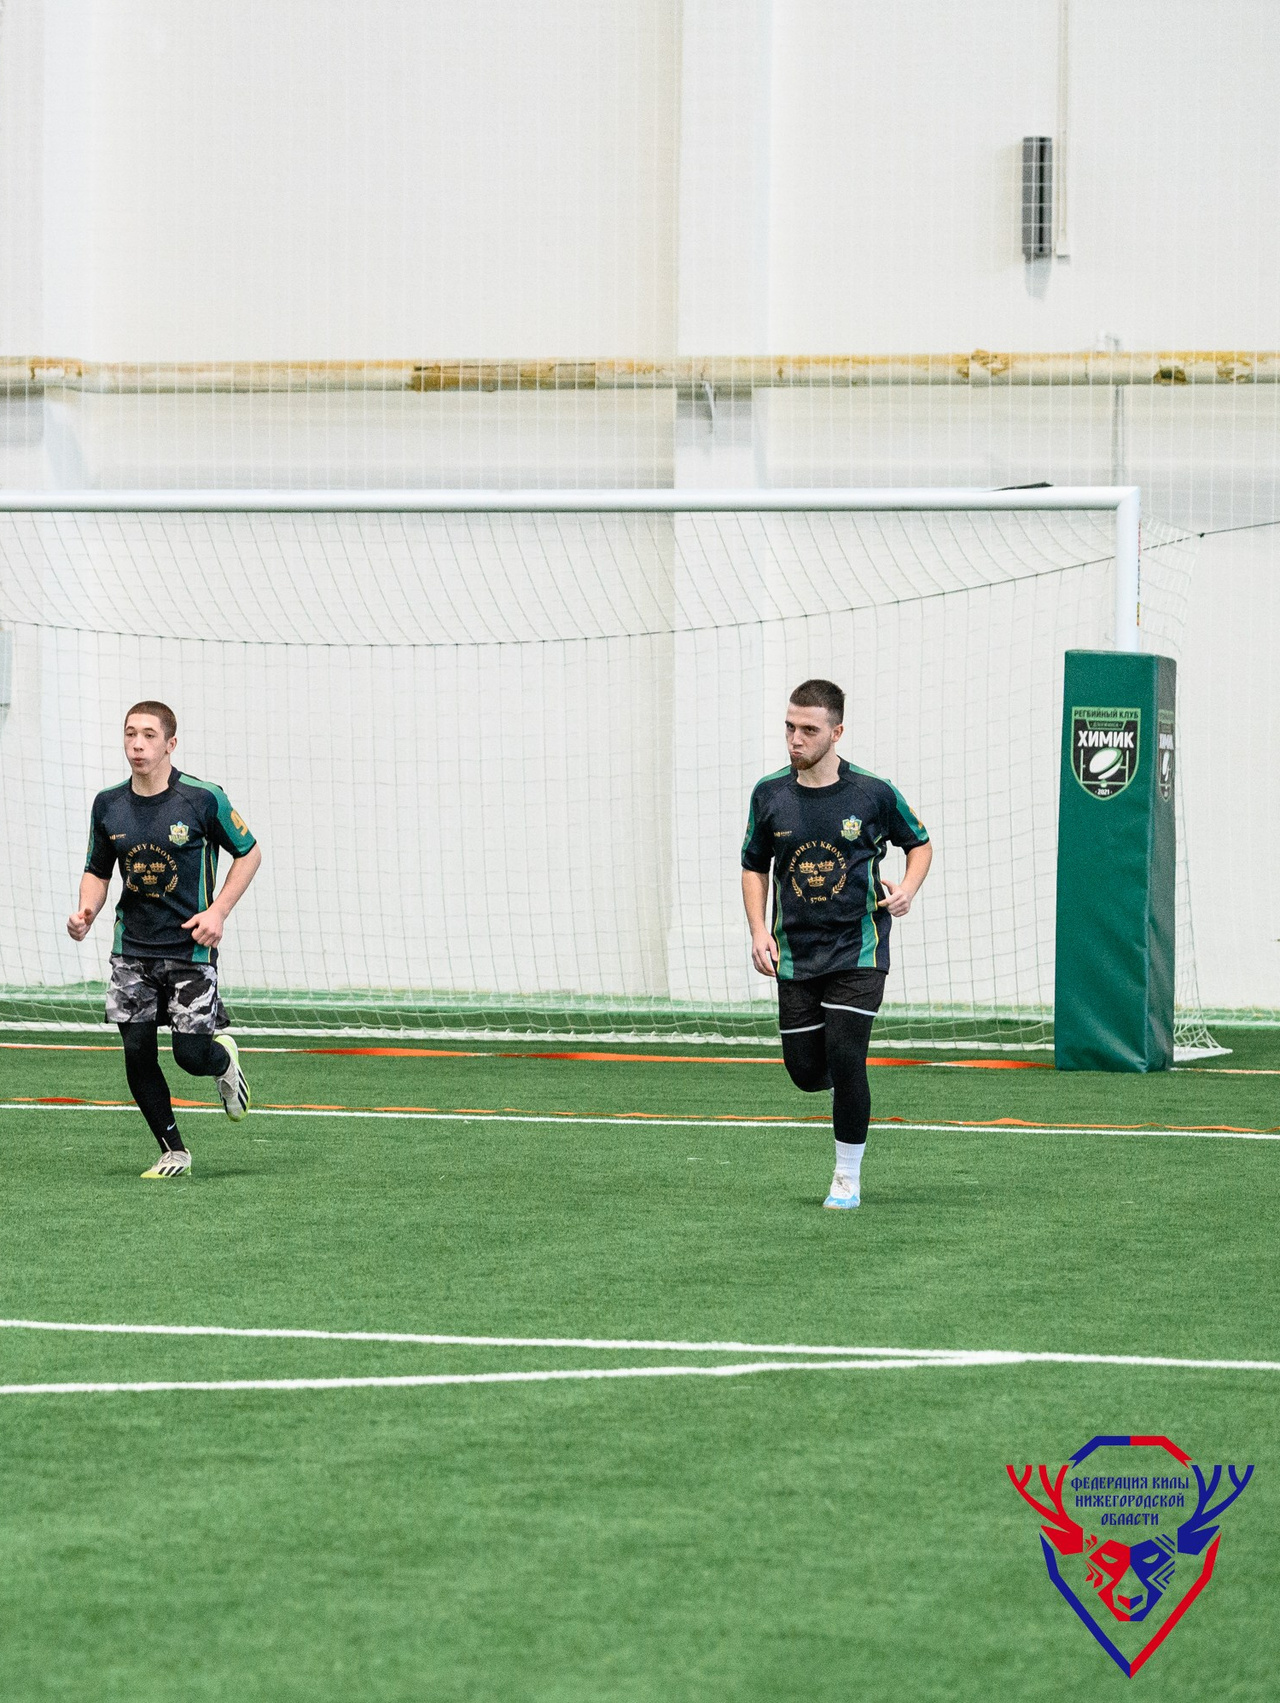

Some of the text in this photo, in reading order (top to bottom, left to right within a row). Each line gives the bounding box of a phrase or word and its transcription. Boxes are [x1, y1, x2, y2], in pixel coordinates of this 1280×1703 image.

[1074, 709, 1139, 719] РЕГБИЙНЫЙ КЛУБ
[1077, 730, 1135, 748] ХИМИК
[230, 809, 248, 837] 9
[128, 843, 148, 858] DREY
[149, 843, 178, 871] KRONEN
[794, 840, 818, 857] DREY
[820, 840, 847, 870] KRONEN
